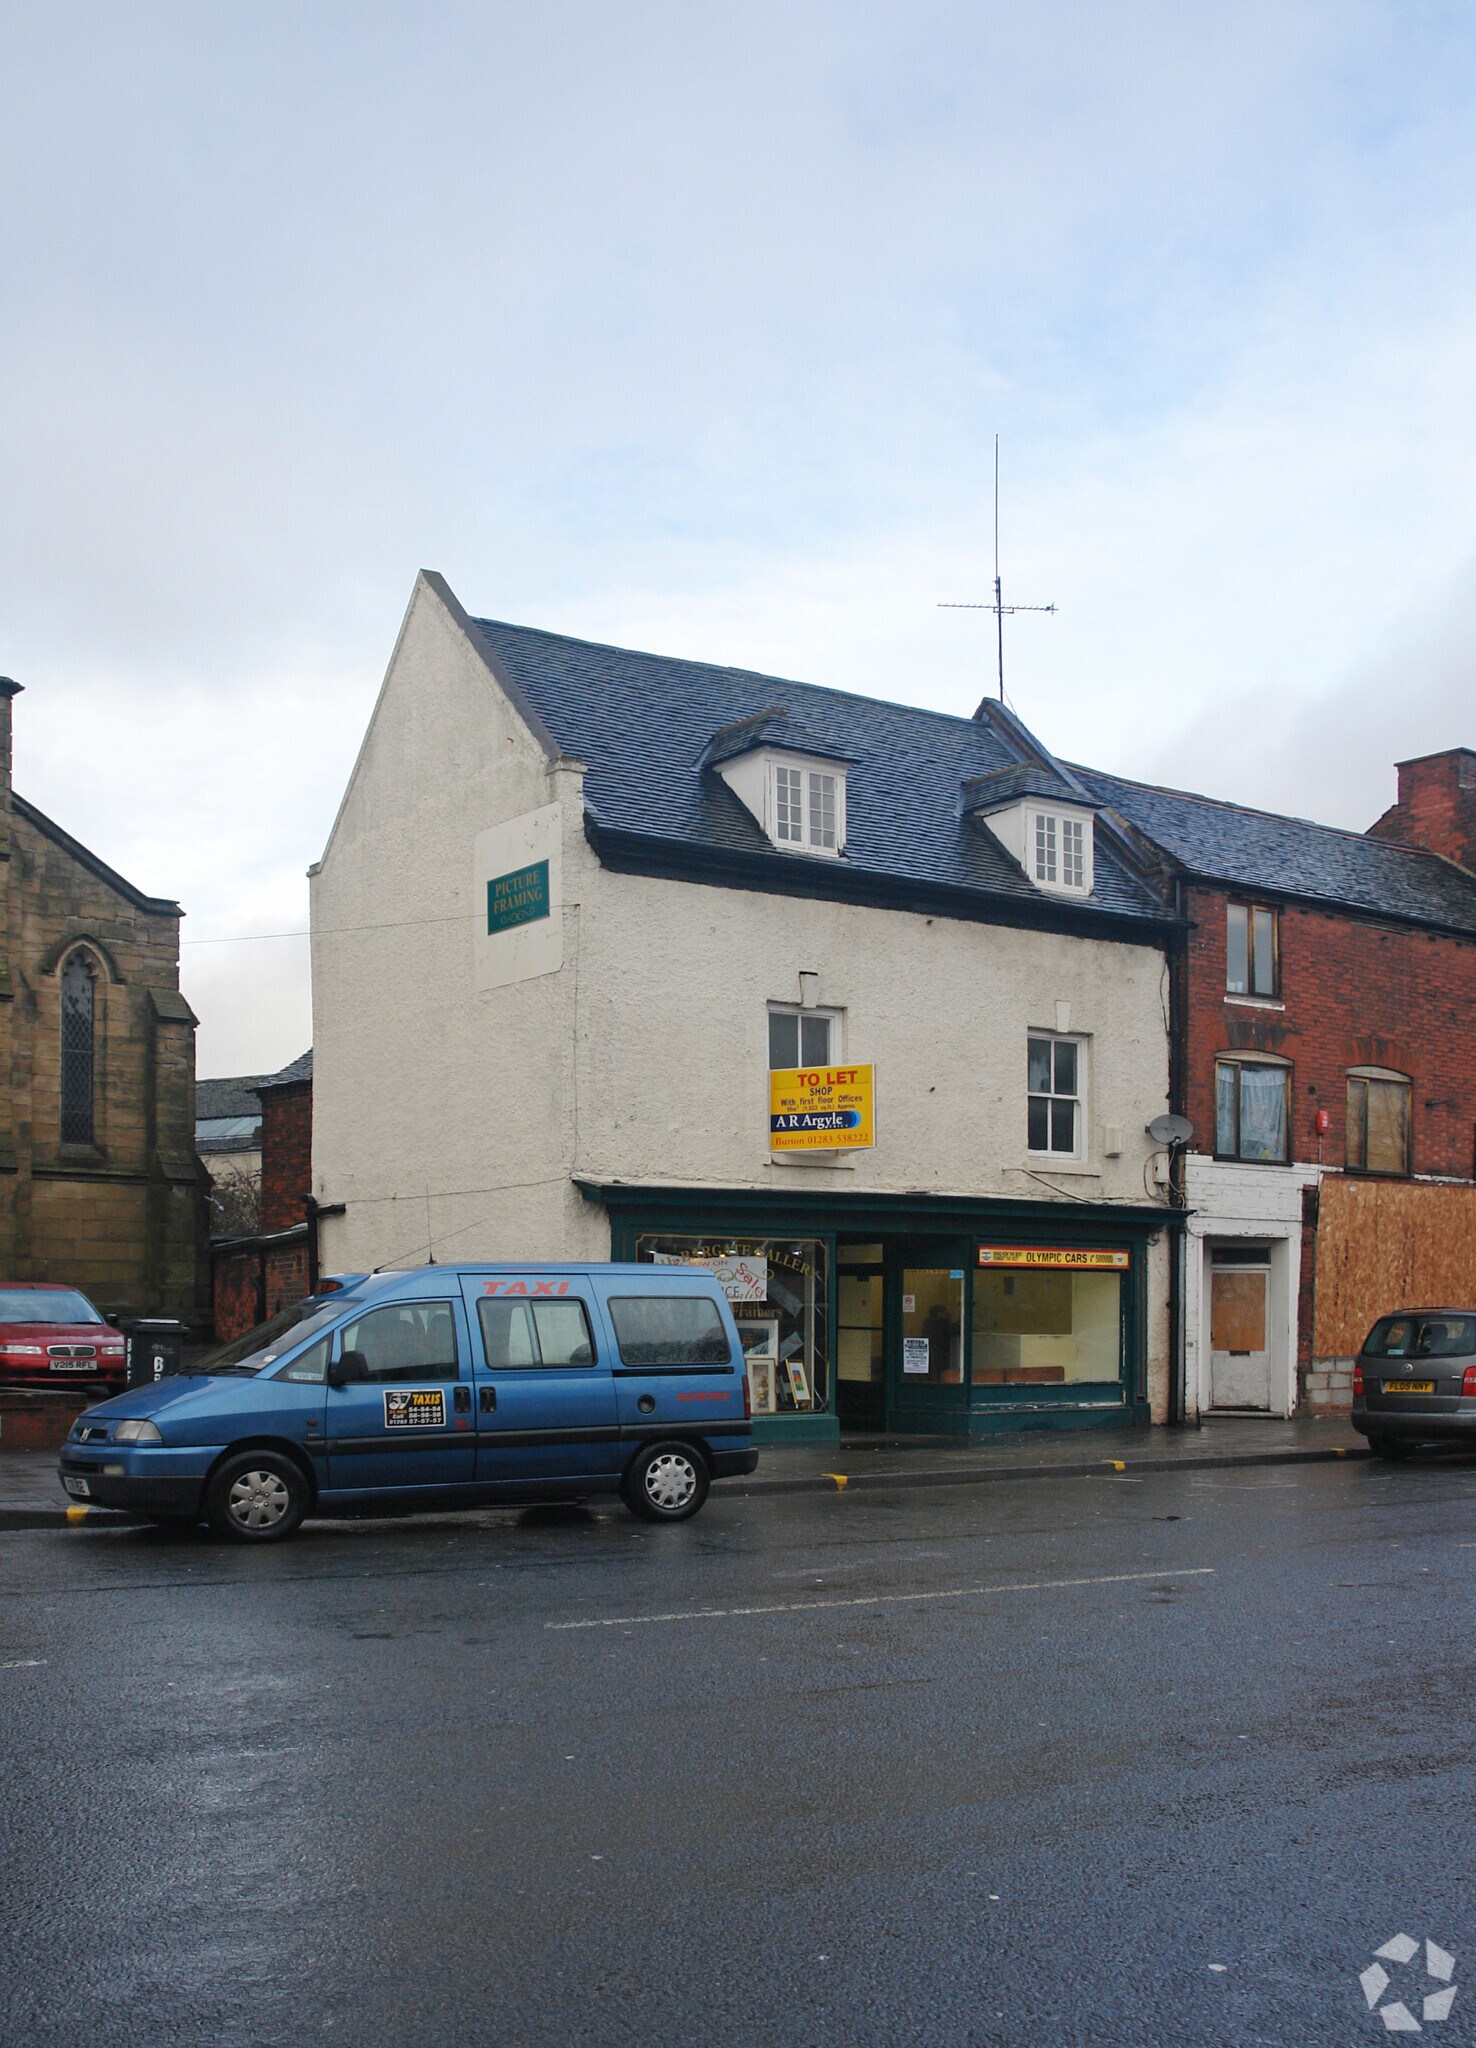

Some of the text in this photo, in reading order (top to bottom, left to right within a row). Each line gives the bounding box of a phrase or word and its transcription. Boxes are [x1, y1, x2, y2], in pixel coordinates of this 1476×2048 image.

[495, 870, 540, 897] PICTURE
[494, 886, 542, 914] FRAMING
[797, 1070, 858, 1087] TO LET
[809, 1086, 833, 1096] SHOP
[781, 1098, 796, 1106] With
[800, 1097, 814, 1105] first
[818, 1096, 833, 1104] floor
[776, 1112, 843, 1130] A R Argyle
[775, 1133, 869, 1146] Burton 01283 538222
[1026, 1251, 1062, 1263] OLYMPIC
[1065, 1253, 1087, 1263] CARS
[482, 1281, 570, 1295] TAXI
[53, 1361, 94, 1369] V215 RFL
[388, 1392, 441, 1410] 57 TAXIS
